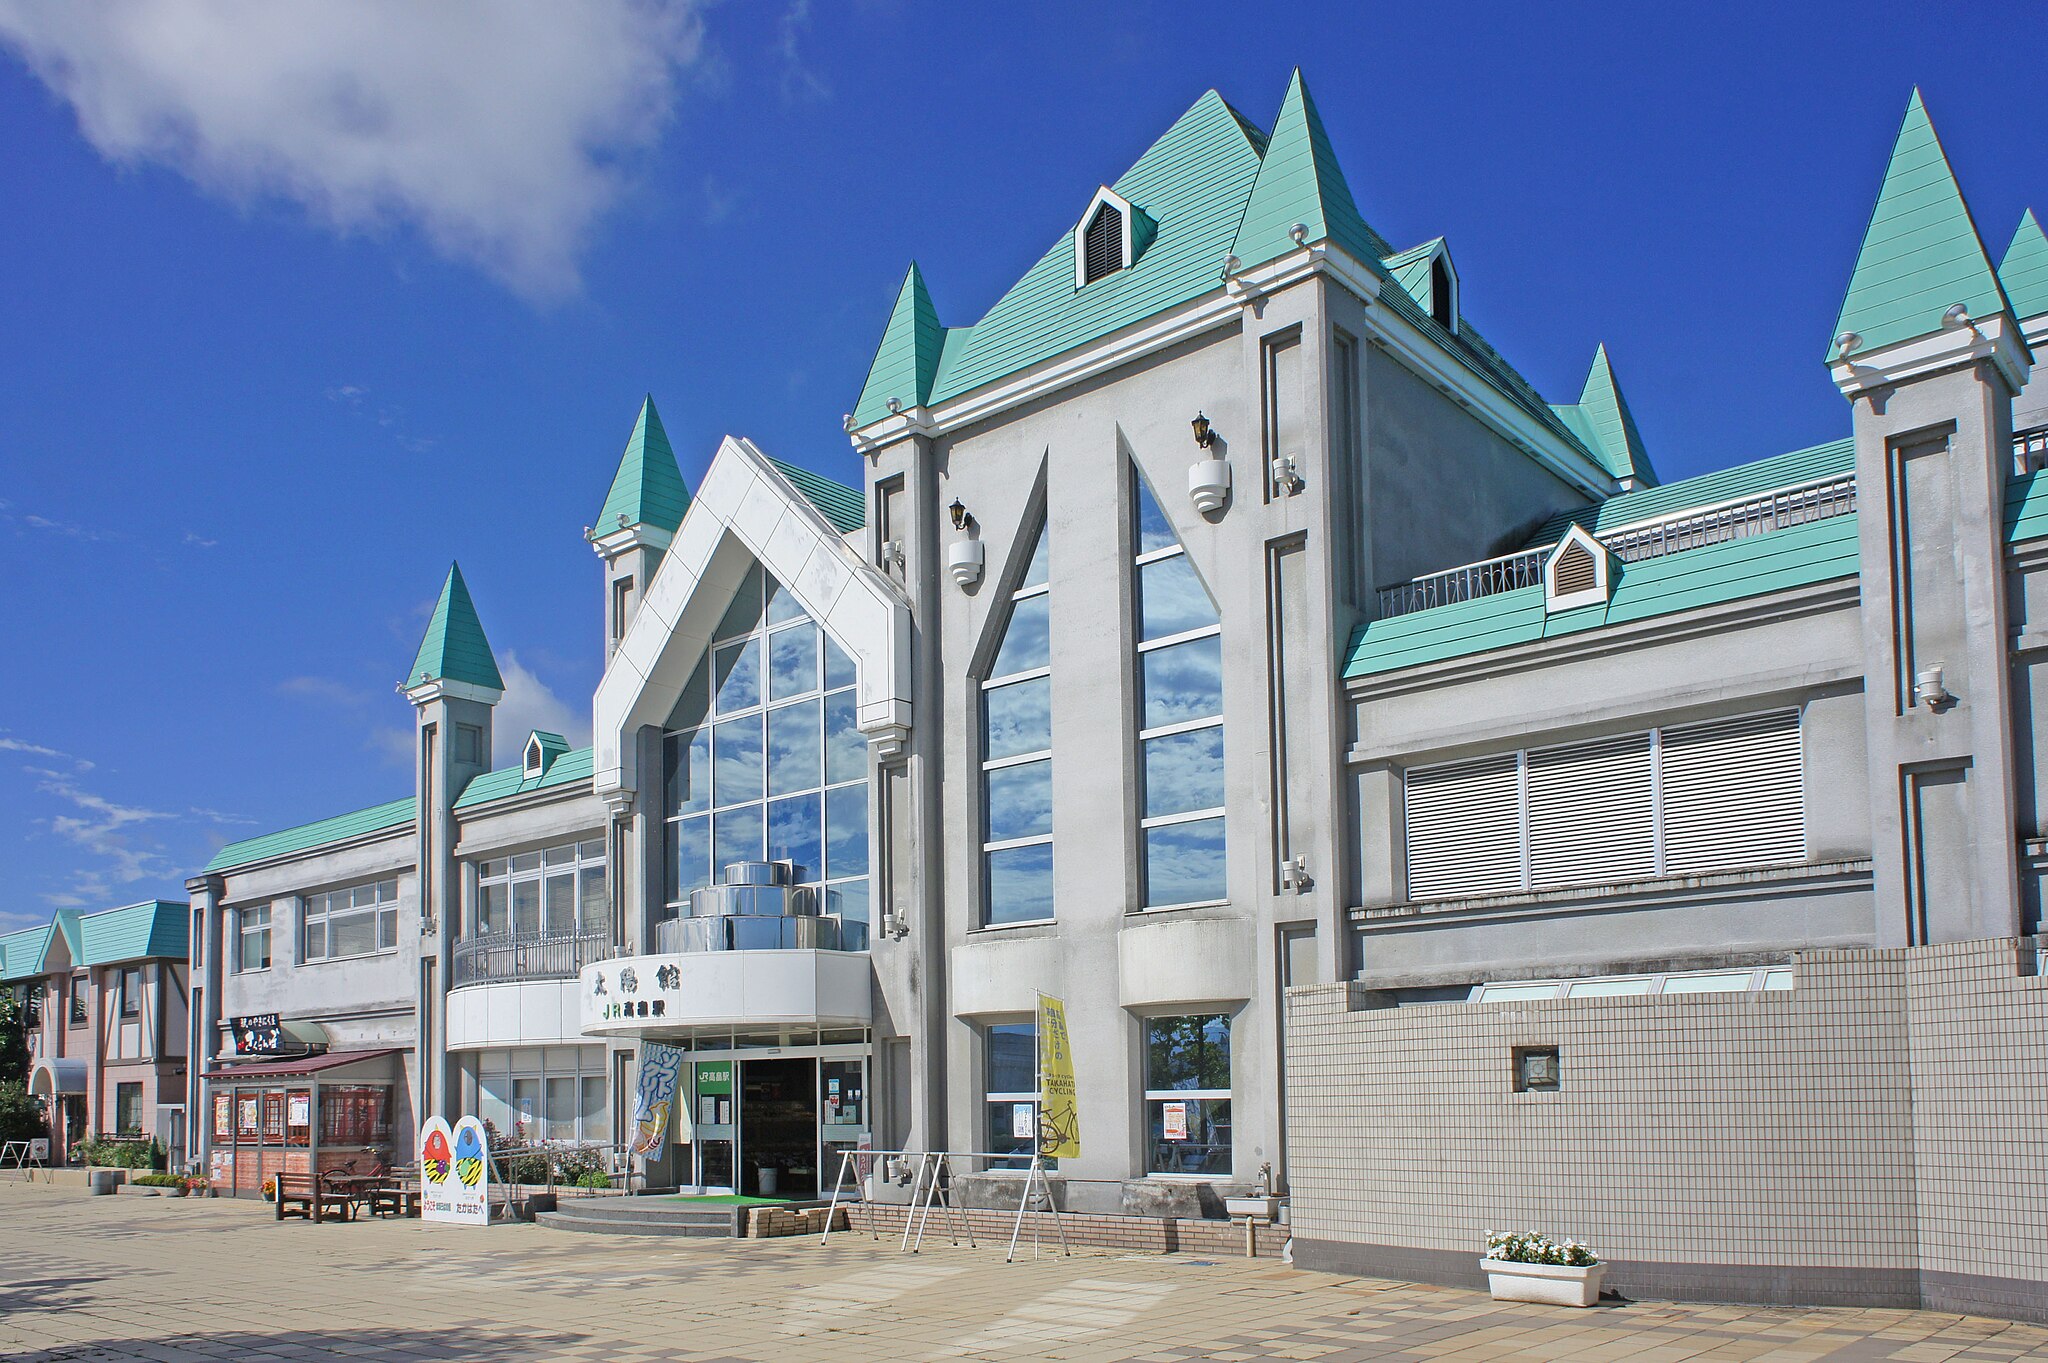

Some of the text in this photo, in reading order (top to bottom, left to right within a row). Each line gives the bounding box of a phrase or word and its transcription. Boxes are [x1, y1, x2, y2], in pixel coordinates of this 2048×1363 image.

[594, 964, 680, 996] 太陽館
[699, 1071, 730, 1082] JR高畠駅
[456, 1202, 484, 1215] たかはたへ
